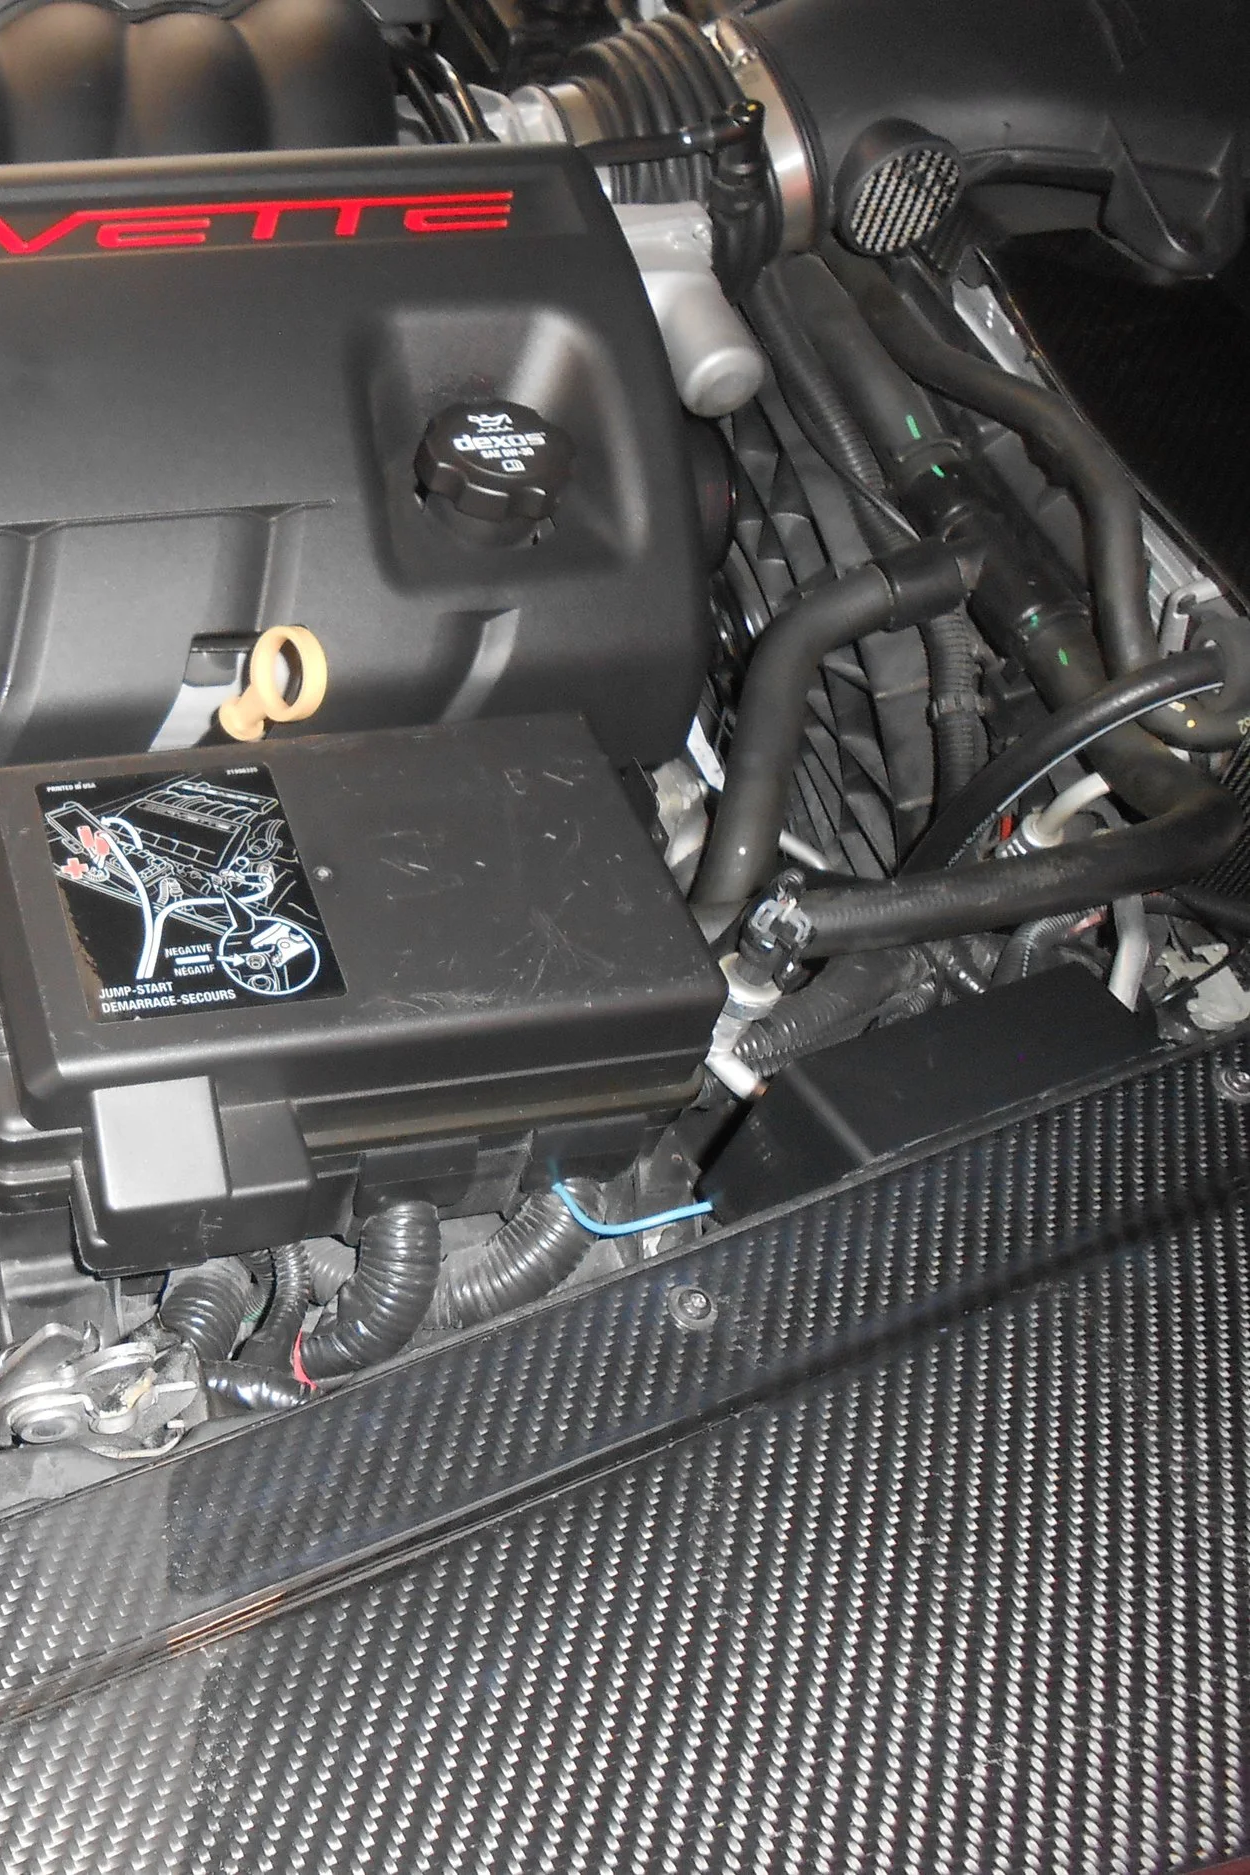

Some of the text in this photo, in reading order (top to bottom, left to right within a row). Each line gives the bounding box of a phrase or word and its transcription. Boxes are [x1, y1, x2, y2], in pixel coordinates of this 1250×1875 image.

[453, 432, 546, 452] dexos
[46, 784, 74, 793] PRINTED
[82, 782, 97, 790] USA
[164, 943, 214, 958] NEGATIVE
[99, 981, 174, 999] JUMP-START
[101, 989, 237, 1014] DEMARRAGE-SECOURS
